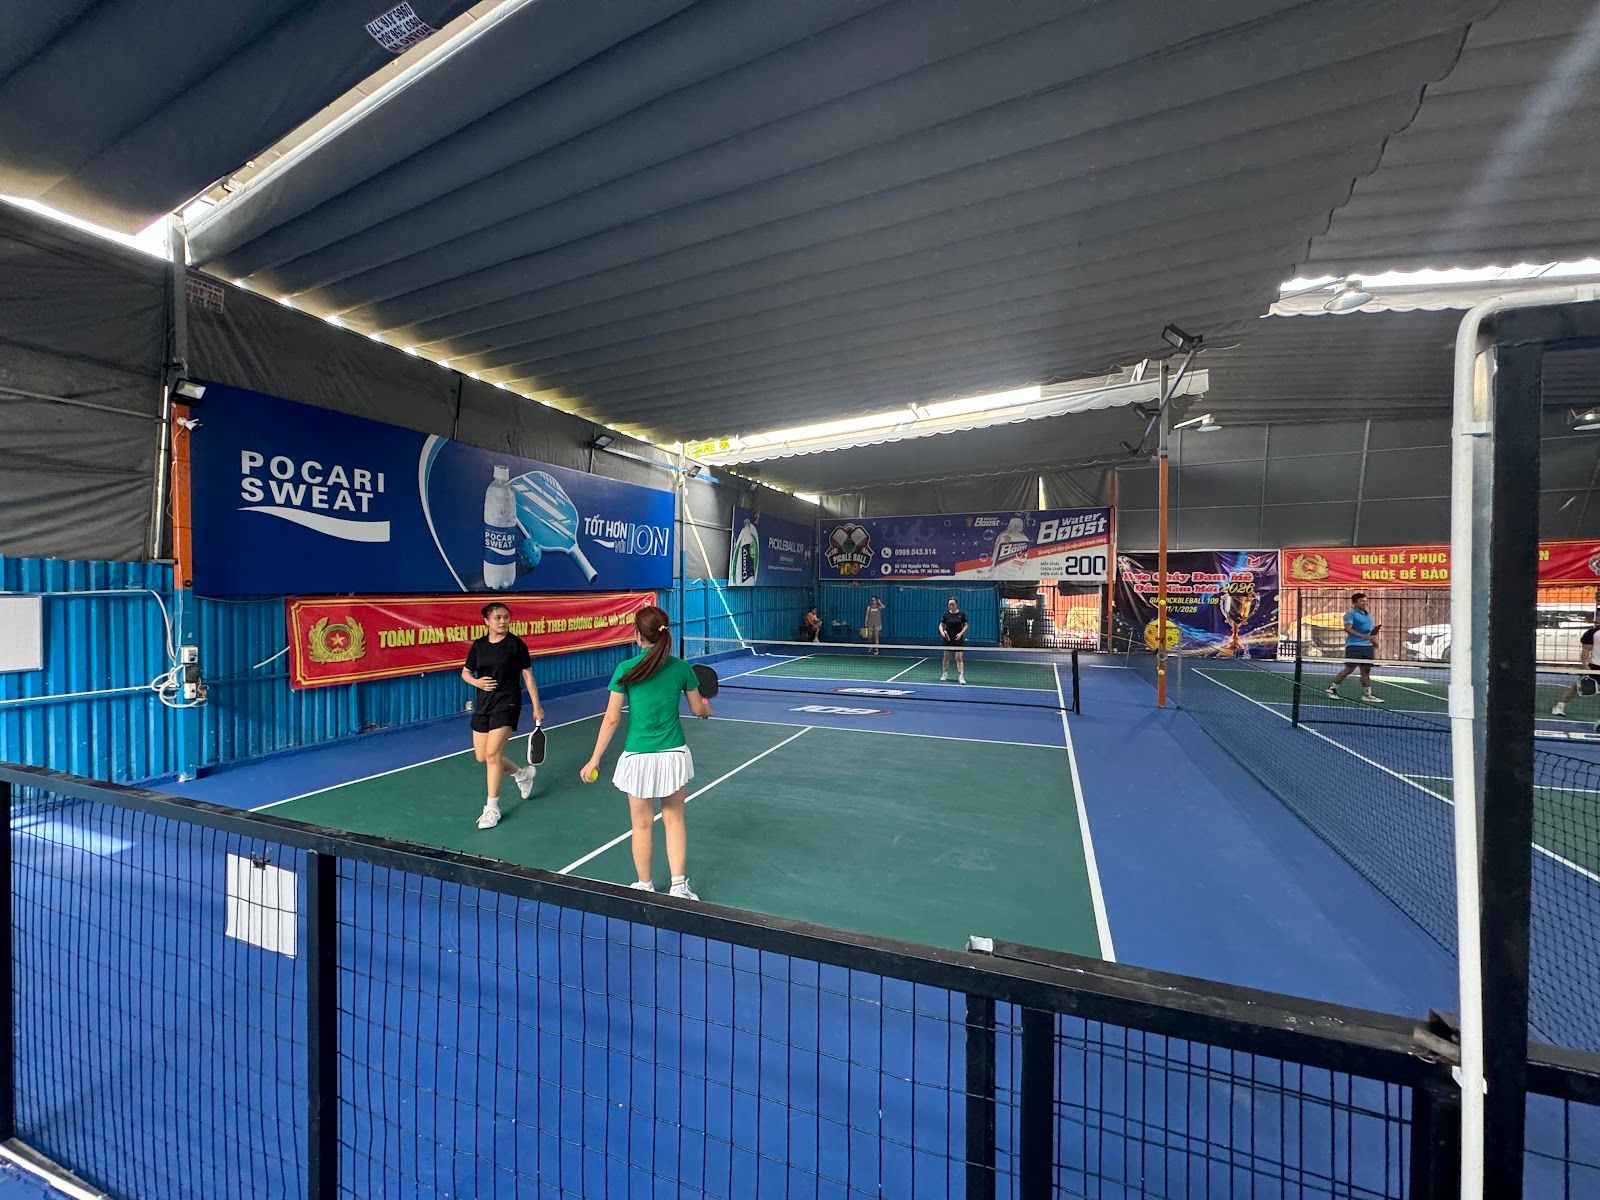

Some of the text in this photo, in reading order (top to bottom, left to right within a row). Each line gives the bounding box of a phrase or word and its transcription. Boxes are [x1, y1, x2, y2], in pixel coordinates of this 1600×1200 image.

[241, 450, 385, 493] POCARI
[240, 477, 374, 513] SWEAT
[584, 513, 628, 539] TỐT HƠN
[1061, 512, 1102, 526] Water
[484, 531, 515, 542] POCARI
[626, 523, 670, 557] ION
[1036, 517, 1108, 545] Boost
[484, 538, 513, 549] SWEAT
[832, 553, 867, 564] PICKLE BALL
[1065, 555, 1106, 576] 200
[1389, 550, 1406, 564] ĐỂ
[1409, 552, 1447, 565] PHỤC
[1400, 566, 1417, 580] ĐỂ
[1420, 566, 1448, 580] BẢO
[1221, 582, 1255, 593] 2026
[378, 627, 415, 648] TOÀN
[418, 625, 444, 645] DÂN
[446, 624, 468, 642] RÈN
[471, 624, 489, 640] LUY
[547, 618, 567, 632] THEO
